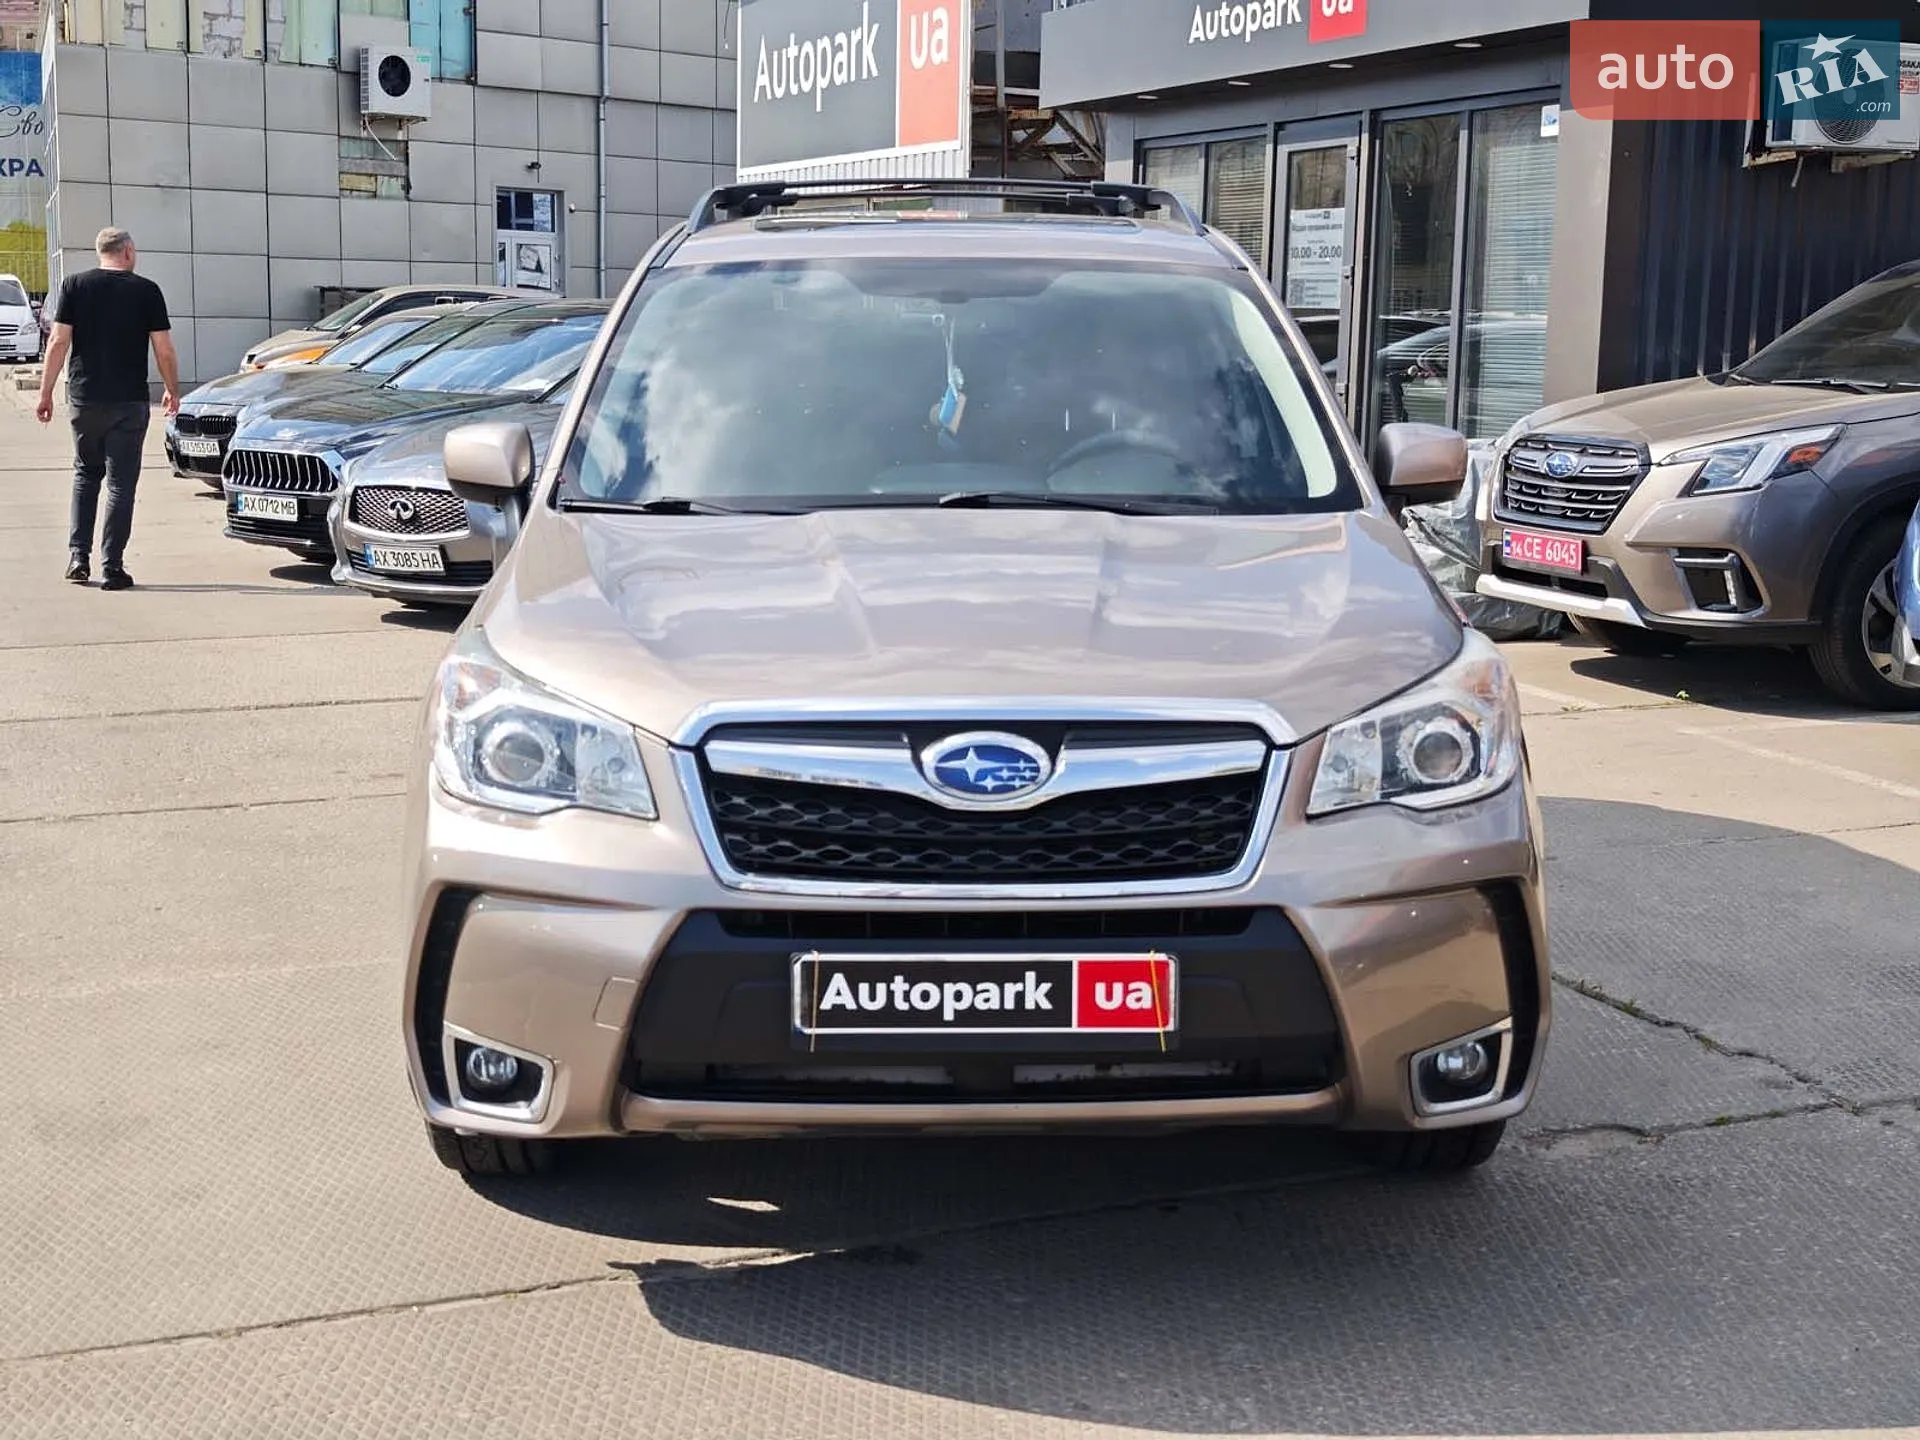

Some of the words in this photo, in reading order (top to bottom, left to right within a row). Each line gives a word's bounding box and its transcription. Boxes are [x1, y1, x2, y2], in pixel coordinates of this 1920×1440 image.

[1188, 0, 1302, 44] Autopark
[754, 1, 880, 112] Autopark
[910, 7, 949, 70] ua
[244, 496, 257, 512] AX
[257, 498, 280, 514] 0712
[281, 501, 296, 515] MB
[374, 549, 390, 566] AX
[389, 551, 420, 568] 3085
[420, 552, 441, 568] HA
[1545, 541, 1577, 566] 6045
[819, 971, 1053, 1021] Autopark
[1094, 982, 1153, 1010] ua
